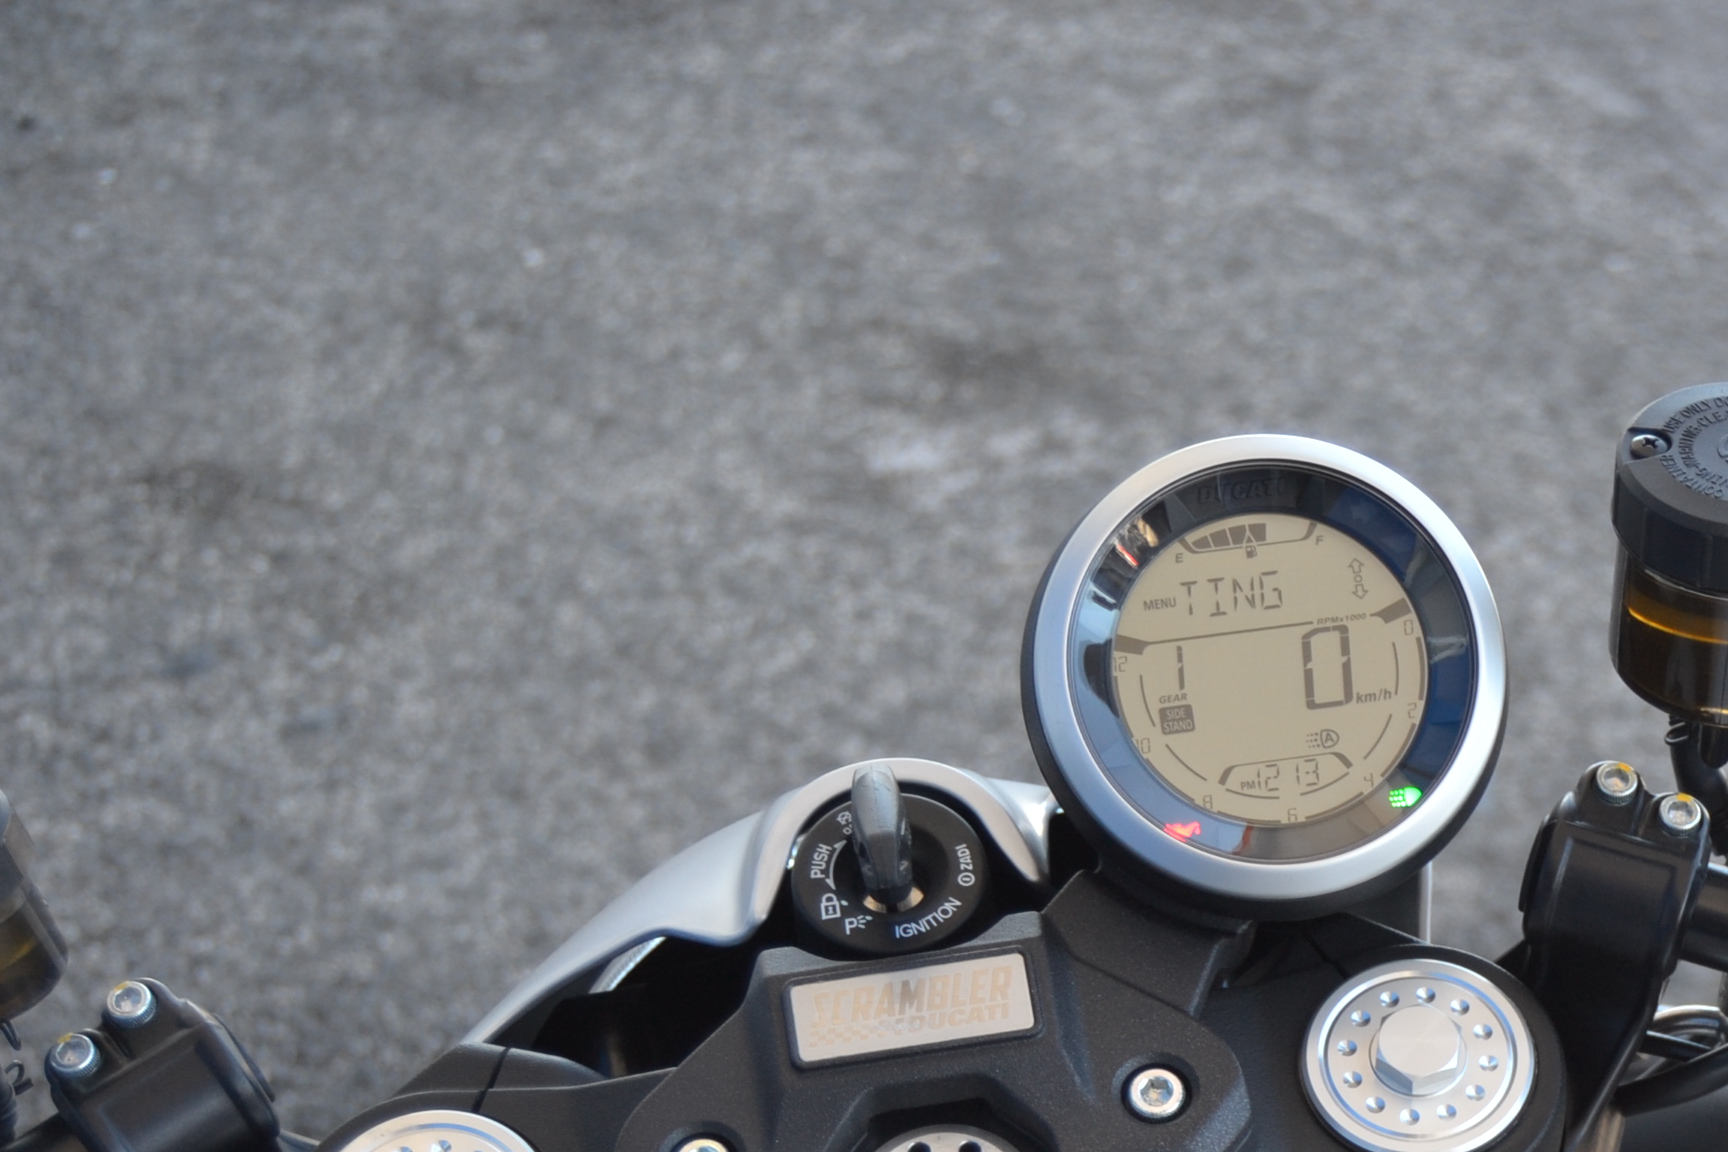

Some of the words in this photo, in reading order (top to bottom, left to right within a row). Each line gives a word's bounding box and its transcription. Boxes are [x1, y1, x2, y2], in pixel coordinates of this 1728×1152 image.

[1680, 399, 1712, 419] ONLY
[1315, 535, 1325, 547] F
[1174, 552, 1185, 564] E
[1143, 597, 1178, 612] MENU
[1179, 570, 1284, 618] TING
[1176, 645, 1186, 691] 1
[1301, 624, 1354, 710] 0
[1158, 692, 1189, 704] GEAR
[1356, 688, 1393, 704] km/h
[1165, 706, 1187, 720] SIDE
[1163, 719, 1194, 734] STAND
[810, 843, 833, 879] PUSH
[895, 896, 963, 939] IGNITION
[810, 964, 1013, 1029] SCRAMBLER
[908, 1001, 1011, 1034] DUCATI
